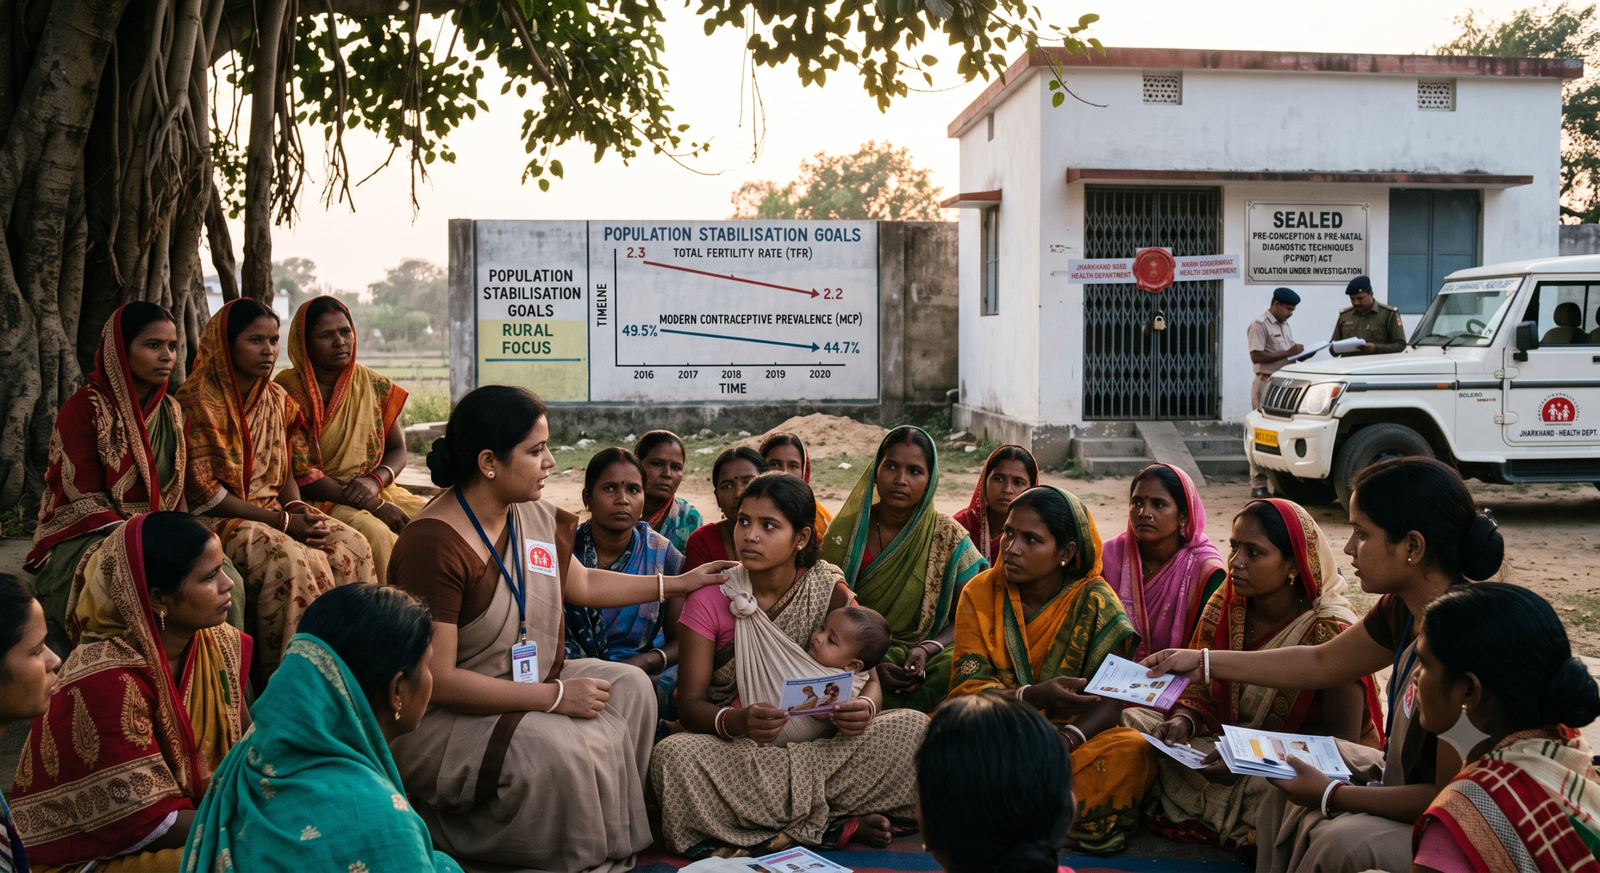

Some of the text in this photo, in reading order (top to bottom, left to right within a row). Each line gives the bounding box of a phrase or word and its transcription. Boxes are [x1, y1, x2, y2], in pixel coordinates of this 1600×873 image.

[1273, 211, 1343, 229] SEALED
[604, 227, 861, 242] POPULATION STABILISATION GOALS
[1252, 232, 1363, 241] PRE-CONCEPTION & PRE-NATAL
[626, 247, 646, 259] 2.3
[673, 246, 813, 261] TOTAL FERTILITY RATE (TFR)
[1262, 243, 1354, 252] DIAGNOSTIC TECHNIQUES
[1283, 254, 1333, 264] (PCPNDT) ACT
[1076, 263, 1111, 271] JHARKHAND
[1202, 267, 1237, 276] DEPARTMENT
[1252, 267, 1363, 275] VIOLATION UNDER INVESTIGATION
[489, 269, 573, 283] POPULATION
[1094, 271, 1131, 279] DEPARTMENT
[483, 287, 581, 300] STABILISATION
[823, 288, 844, 300] 2.2
[507, 304, 554, 318] GOALS
[659, 312, 863, 327] MODERN CONTRACEPTIVE PREVALENCE (MCP)
[502, 323, 554, 337] RURAL
[622, 324, 658, 338] 49.5%
[502, 341, 552, 355] FOCUS
[823, 341, 860, 355] 44.7%
[633, 369, 831, 380] 2016 2017 2018 2019 2020
[719, 382, 747, 394] TIME
[1519, 429, 1555, 437] JHARKHAND
[1559, 429, 1580, 437] HEALTH
[1581, 429, 1599, 437] DEPT.
